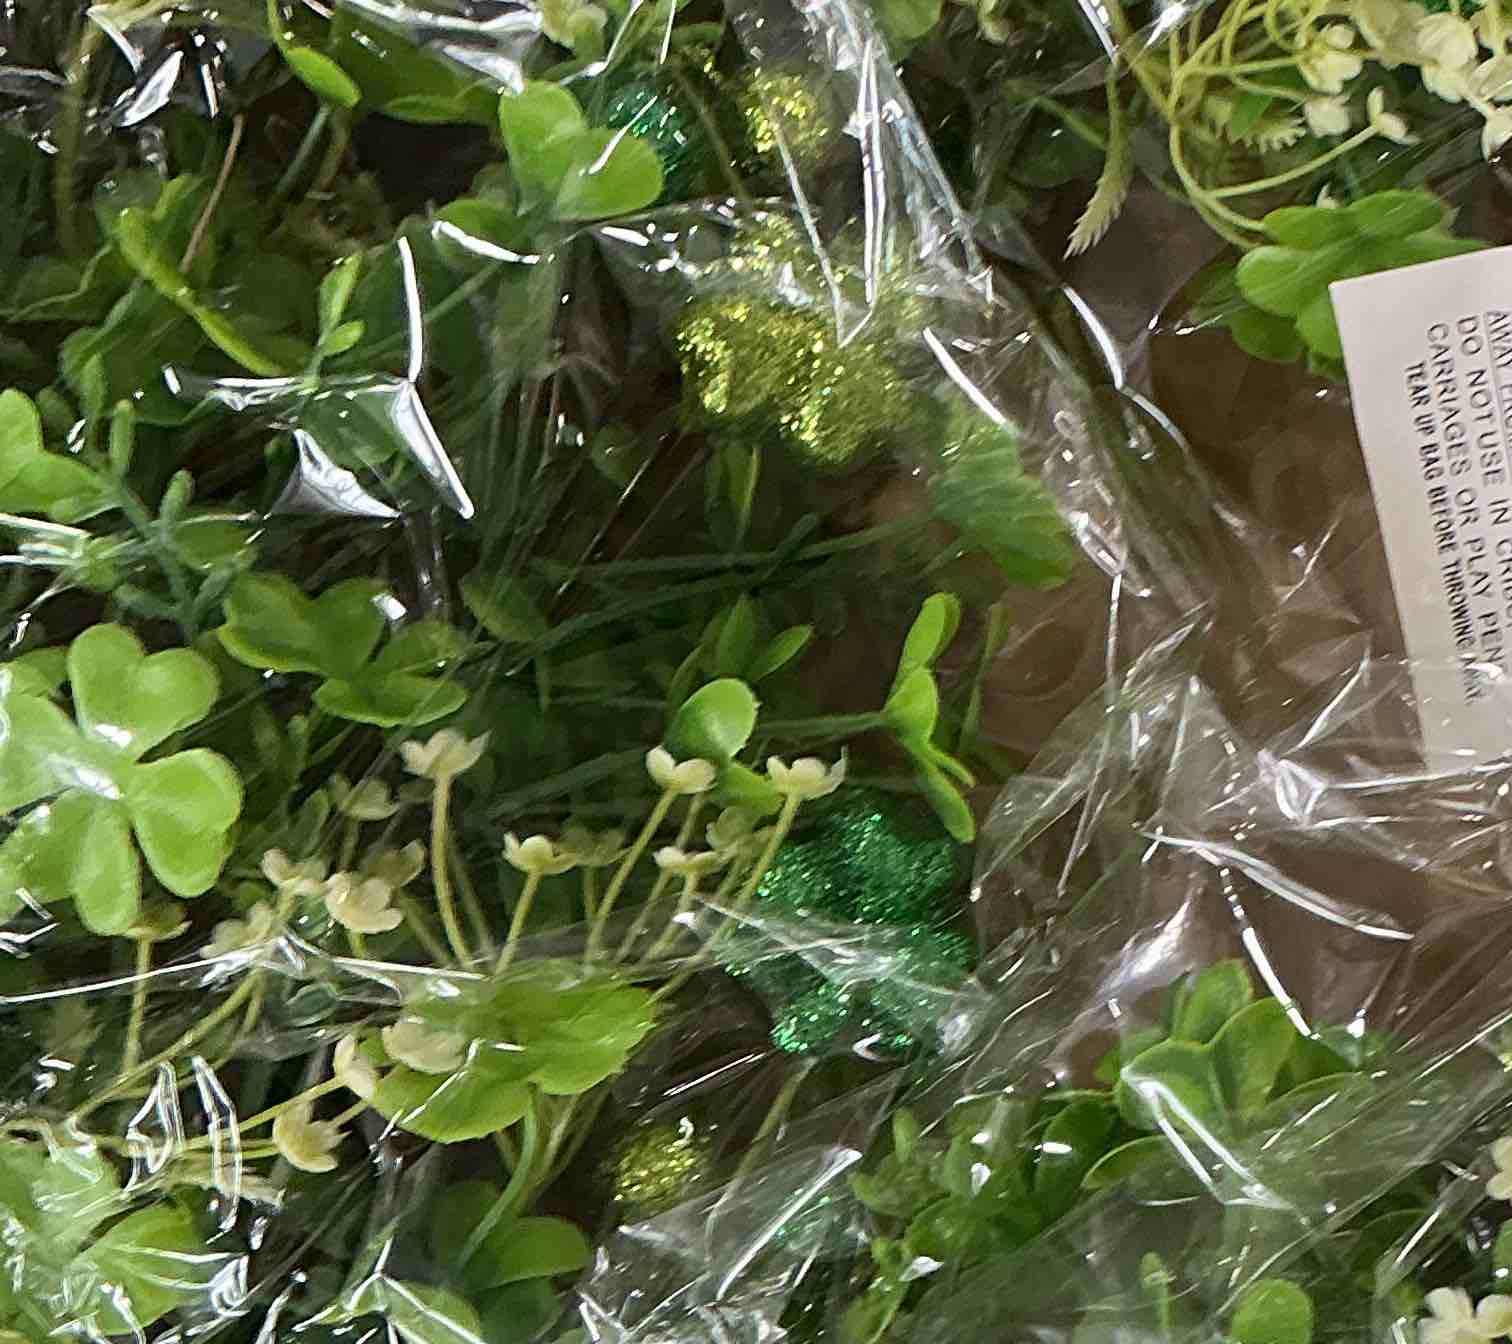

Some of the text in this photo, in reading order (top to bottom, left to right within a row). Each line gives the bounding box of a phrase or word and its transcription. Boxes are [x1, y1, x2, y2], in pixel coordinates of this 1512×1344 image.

[1457, 316, 1482, 355] DO
[1404, 361, 1433, 407] TEAR
[1424, 323, 1473, 476] CARRIAGES
[1466, 369, 1495, 426] NOT
[1414, 413, 1437, 436] UP
[1419, 443, 1445, 480] BAG
[1476, 431, 1505, 486] USE
[1427, 486, 1458, 553] BEFORE
[1454, 488, 1480, 525] OR
[1489, 500, 1511, 524] IN
[1464, 537, 1493, 599] PLAY
[1441, 560, 1476, 647] THROWING
